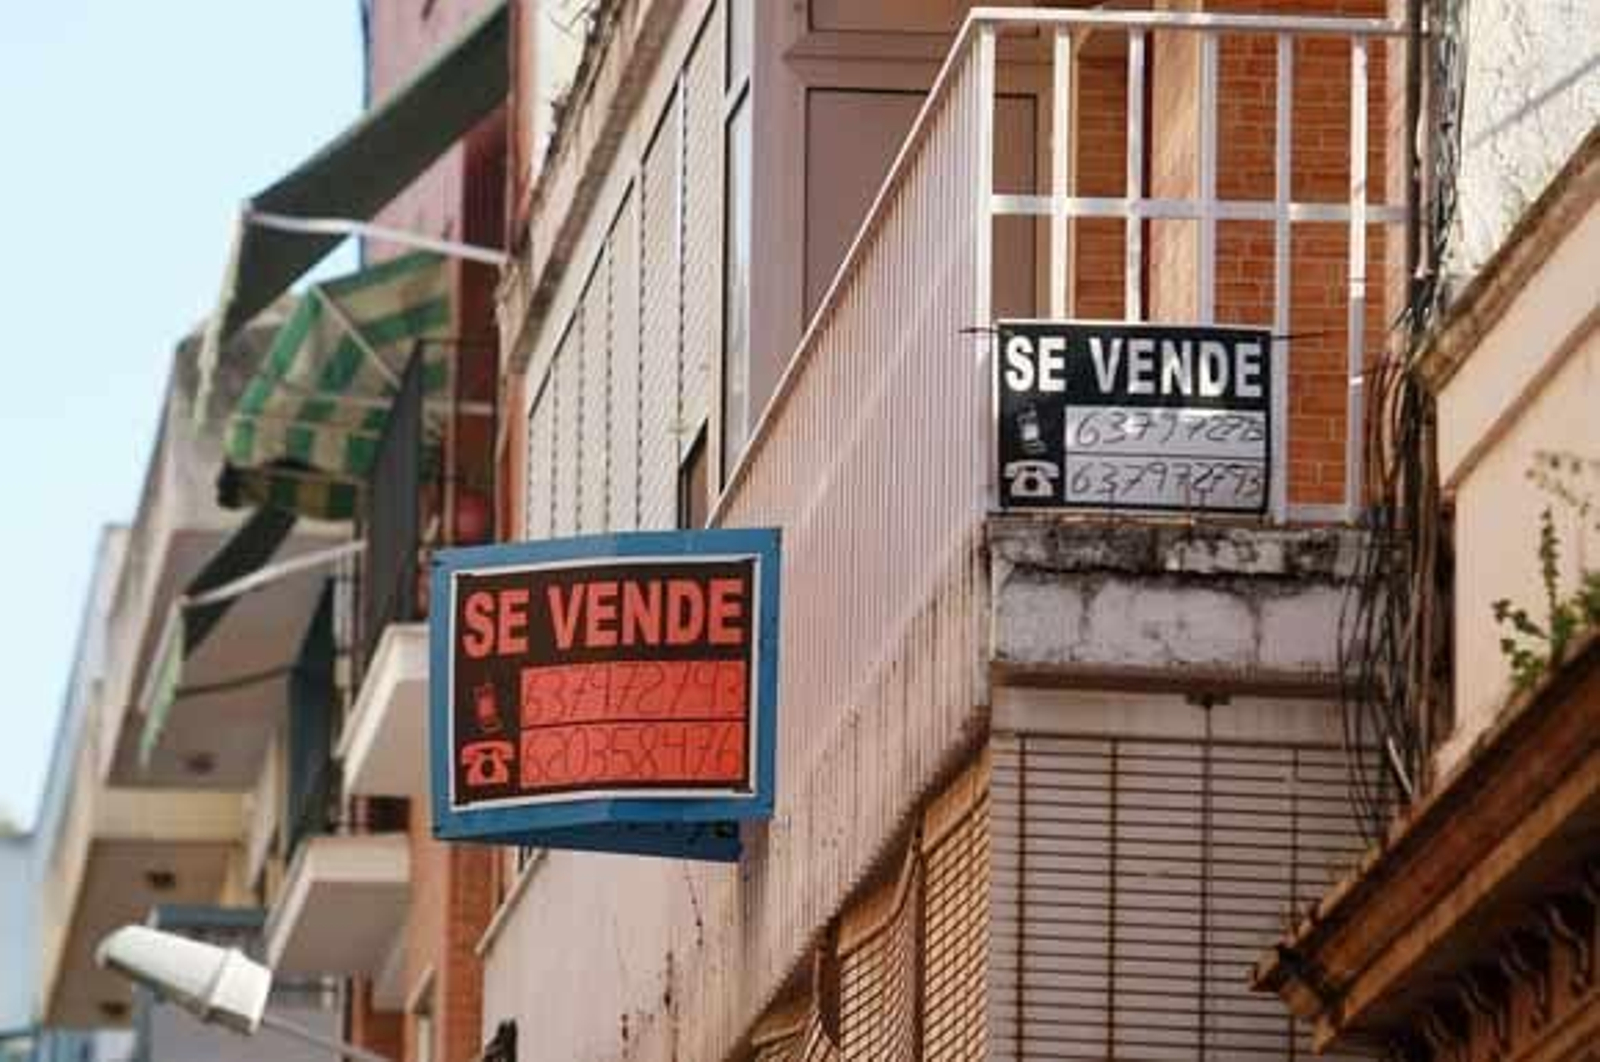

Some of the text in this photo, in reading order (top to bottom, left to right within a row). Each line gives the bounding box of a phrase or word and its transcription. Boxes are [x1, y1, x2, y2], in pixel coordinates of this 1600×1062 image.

[1005, 335, 1263, 397] SE VENDE
[462, 578, 744, 658] SE VENDE
